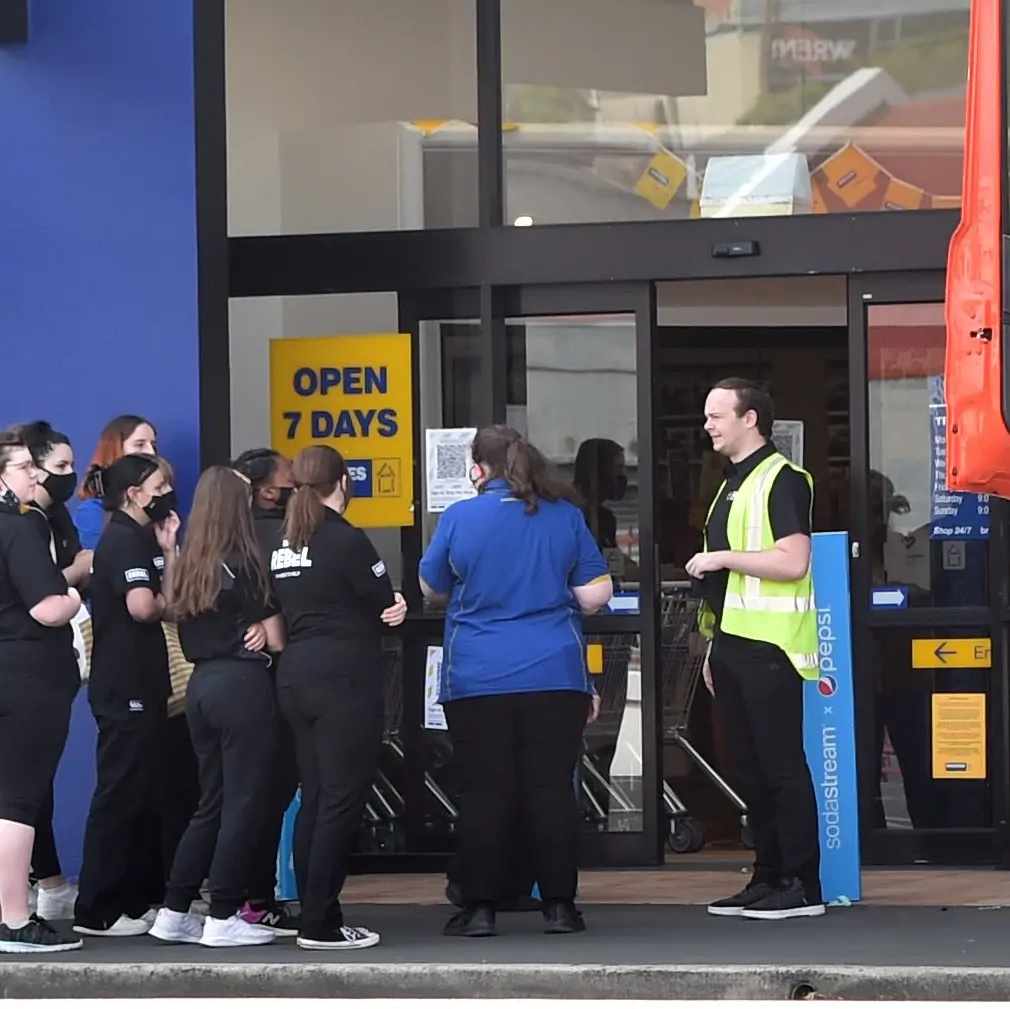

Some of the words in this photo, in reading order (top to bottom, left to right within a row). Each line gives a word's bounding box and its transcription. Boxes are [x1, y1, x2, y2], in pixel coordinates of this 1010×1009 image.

[293, 366, 388, 397] OPEN
[283, 411, 302, 440] 7
[311, 408, 398, 439] DAYS
[934, 505, 958, 517] Sunday
[933, 526, 953, 536] Shop
[818, 608, 838, 672] pepsi
[821, 726, 840, 849] sodastream
